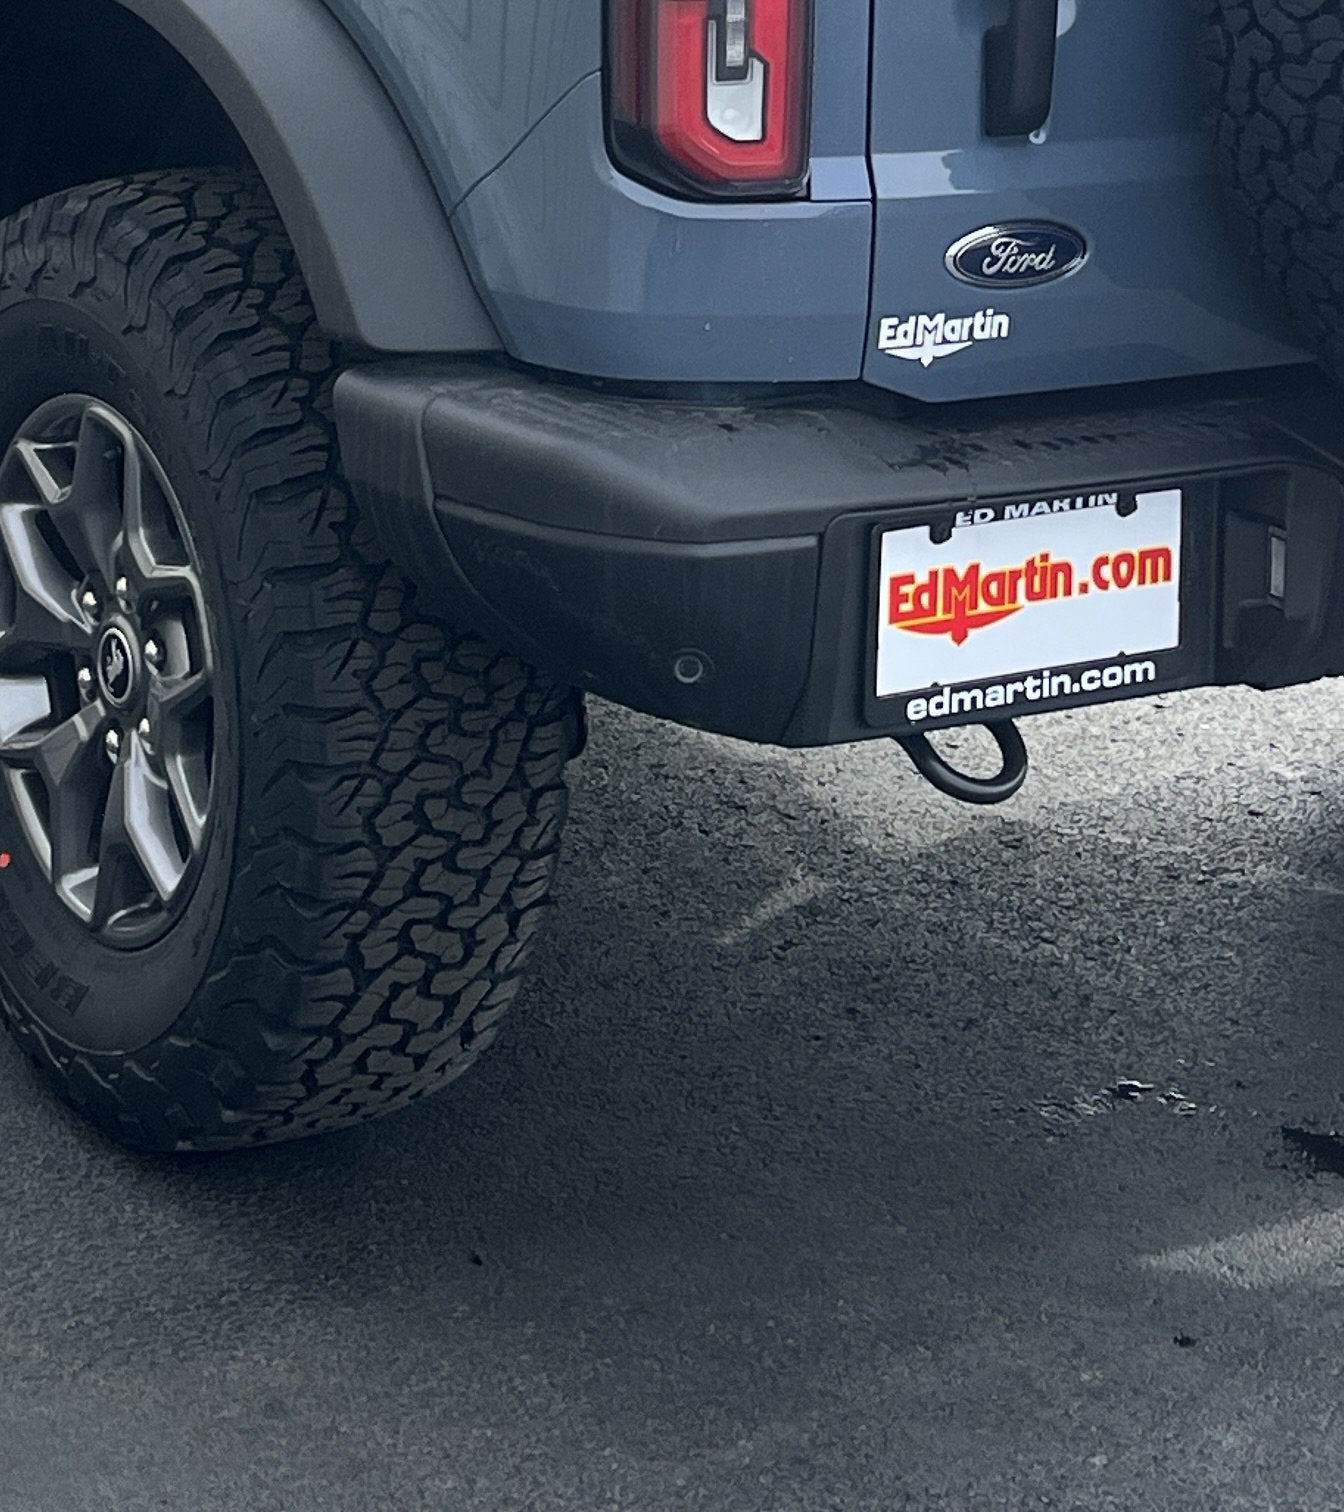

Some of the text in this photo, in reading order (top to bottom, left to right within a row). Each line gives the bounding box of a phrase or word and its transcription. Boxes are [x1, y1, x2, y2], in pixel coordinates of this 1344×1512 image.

[982, 237, 1056, 276] Ford
[877, 308, 1010, 352] EdMartin
[955, 492, 1119, 527] ED MARTIN
[888, 544, 1174, 630] EdMartin.com
[906, 659, 1156, 722] edmartin.com
